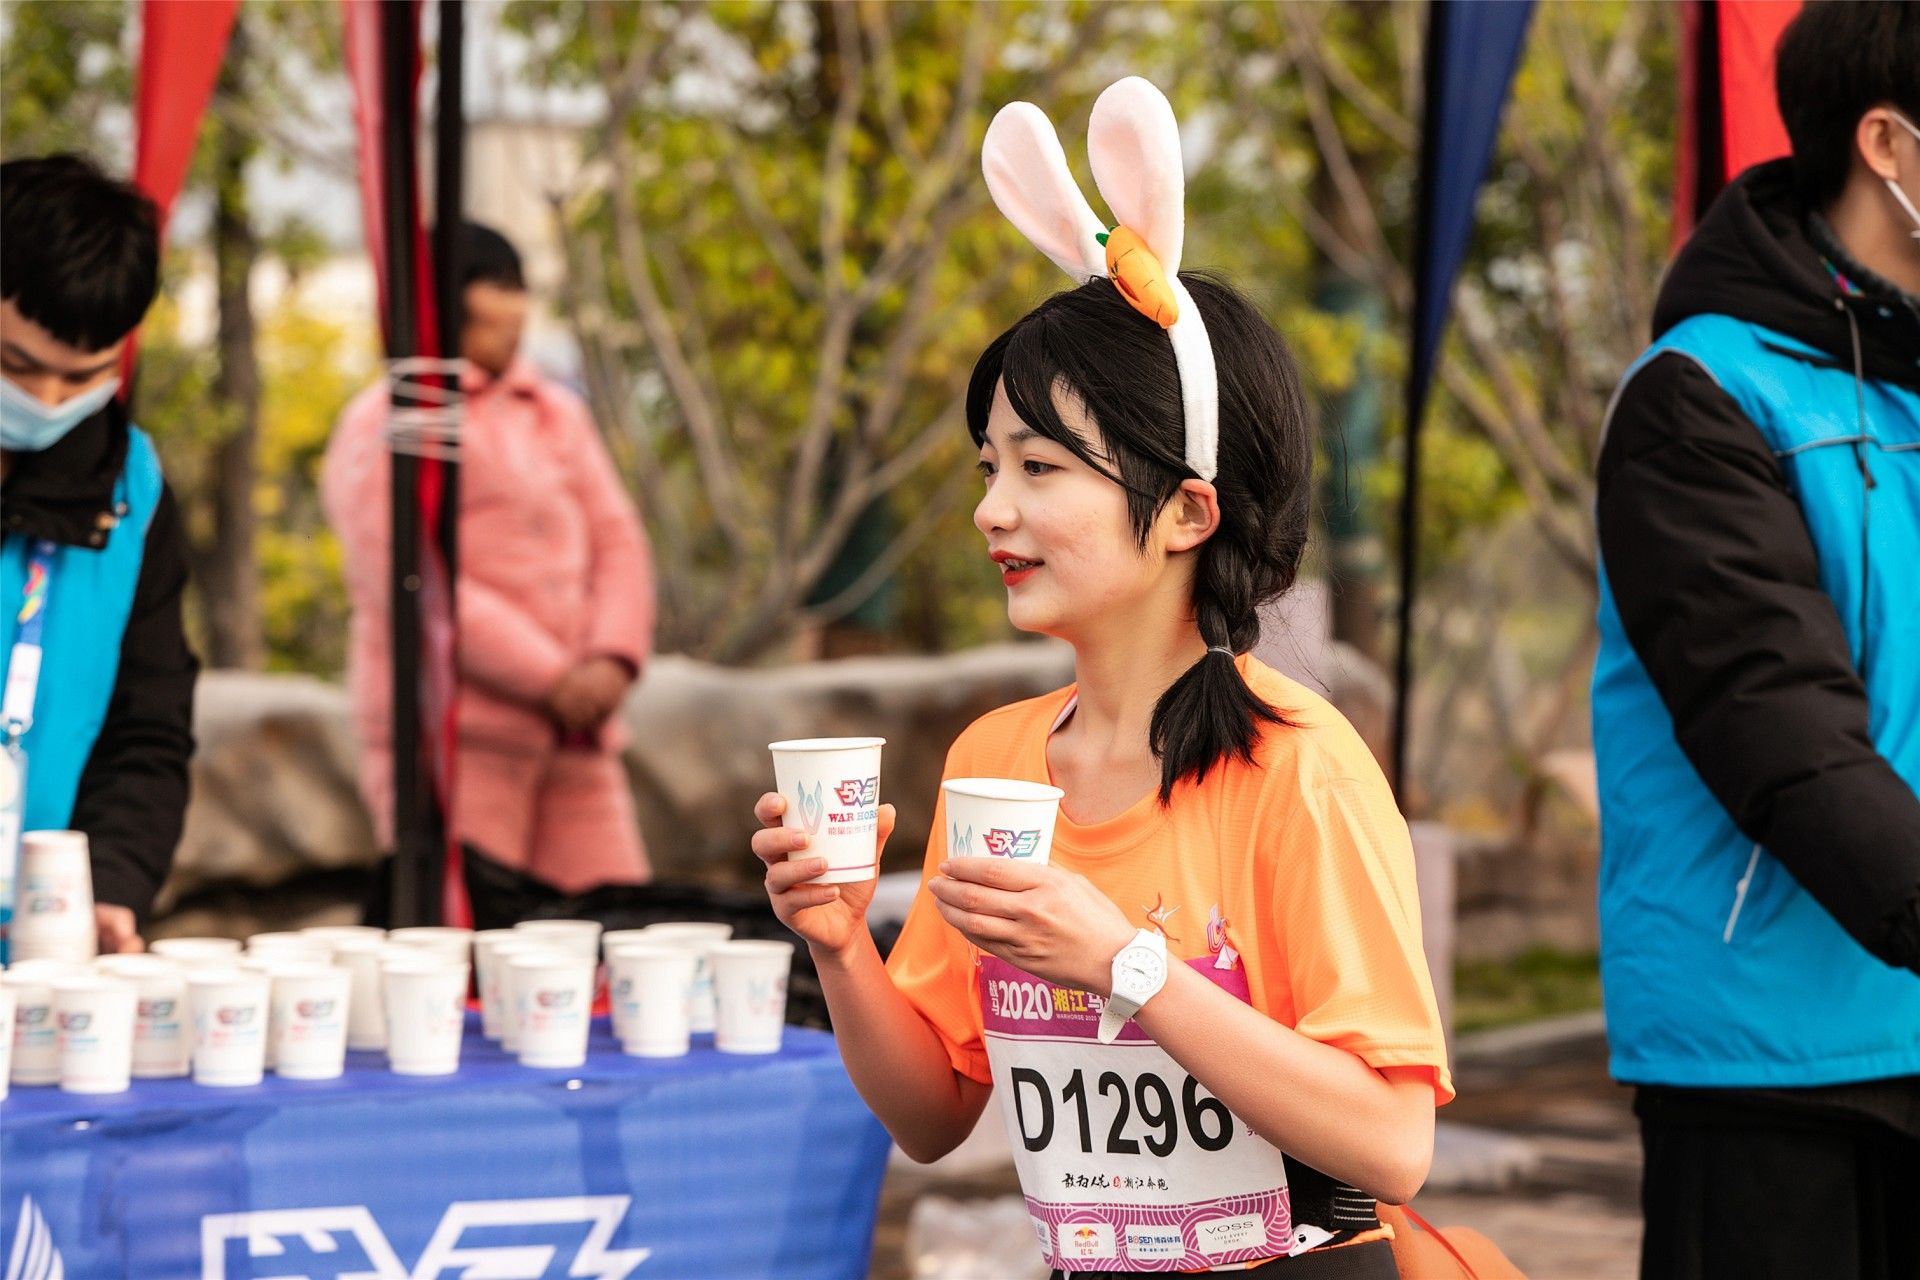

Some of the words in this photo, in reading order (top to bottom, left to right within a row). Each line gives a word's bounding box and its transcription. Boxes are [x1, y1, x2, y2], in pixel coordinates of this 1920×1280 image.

[828, 812, 854, 822] WAR
[1052, 987, 1107, 1014] 湘江马
[1011, 1067, 1234, 1158] D1296
[1205, 1221, 1253, 1235] VOSS
